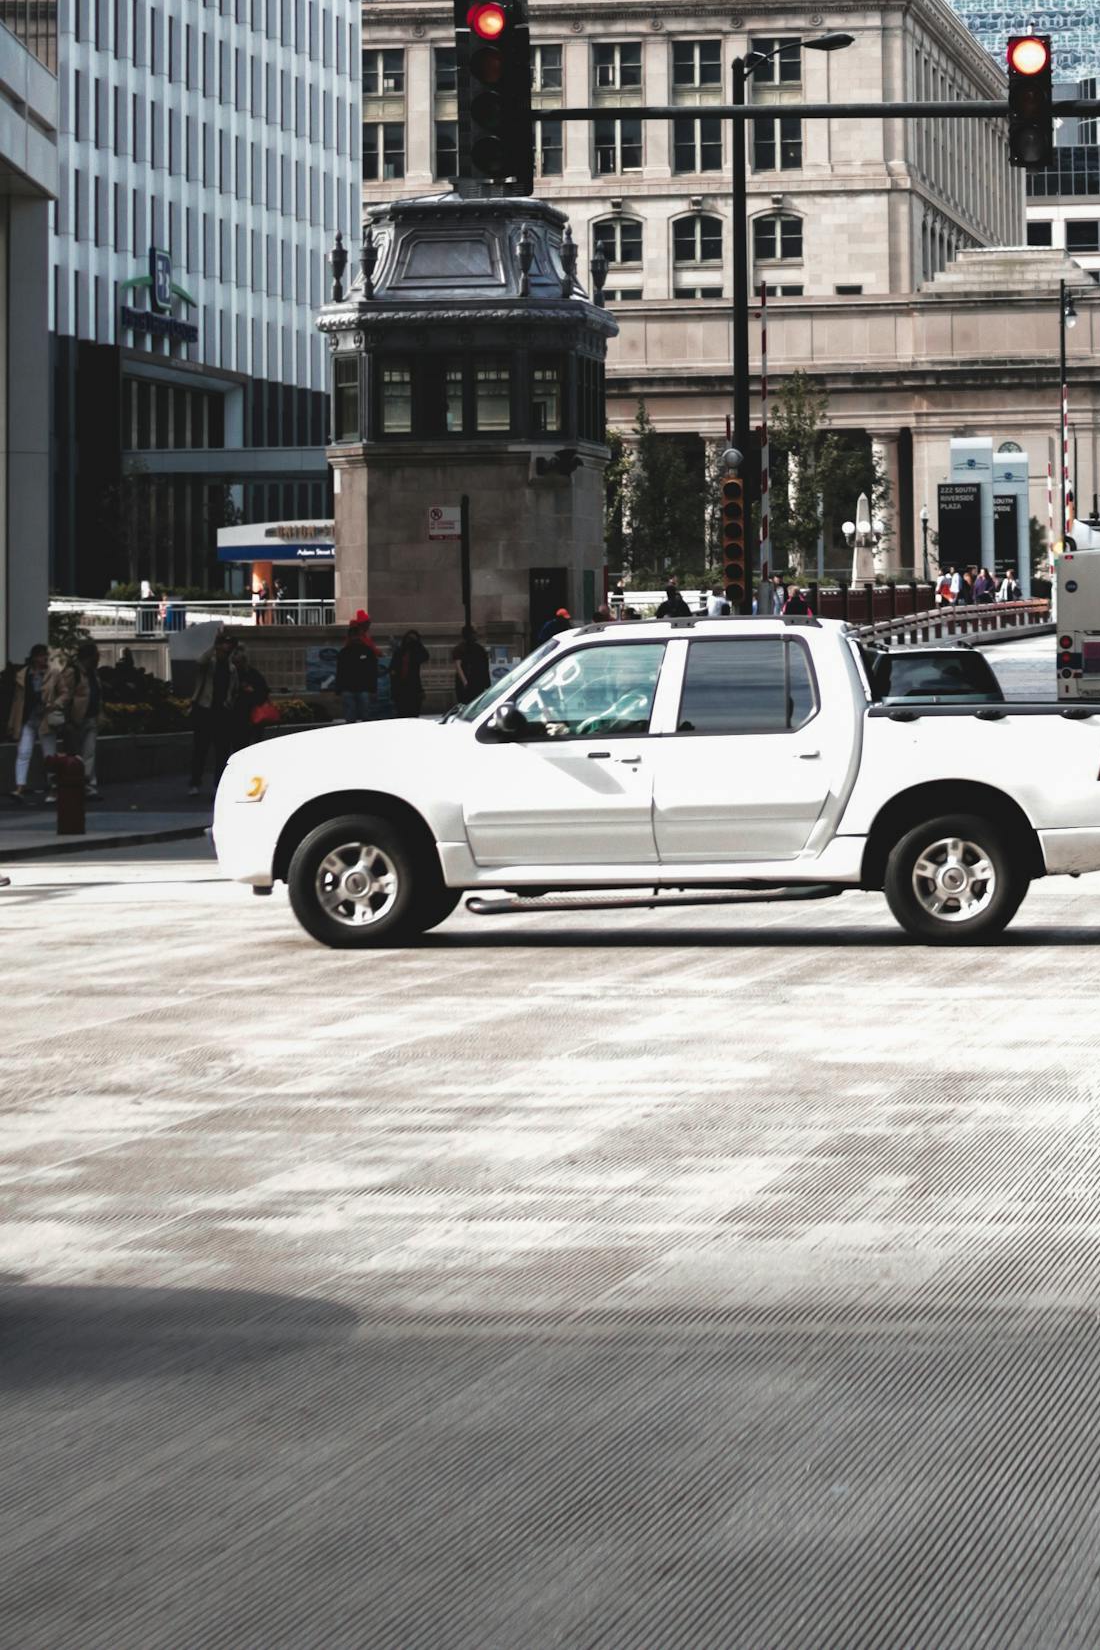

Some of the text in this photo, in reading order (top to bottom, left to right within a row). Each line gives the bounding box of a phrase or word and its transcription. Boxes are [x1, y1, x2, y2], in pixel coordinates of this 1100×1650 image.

[955, 485, 978, 494] SOUTH
[940, 494, 975, 502] RIVERSIDE
[940, 502, 962, 510] PLAZA
